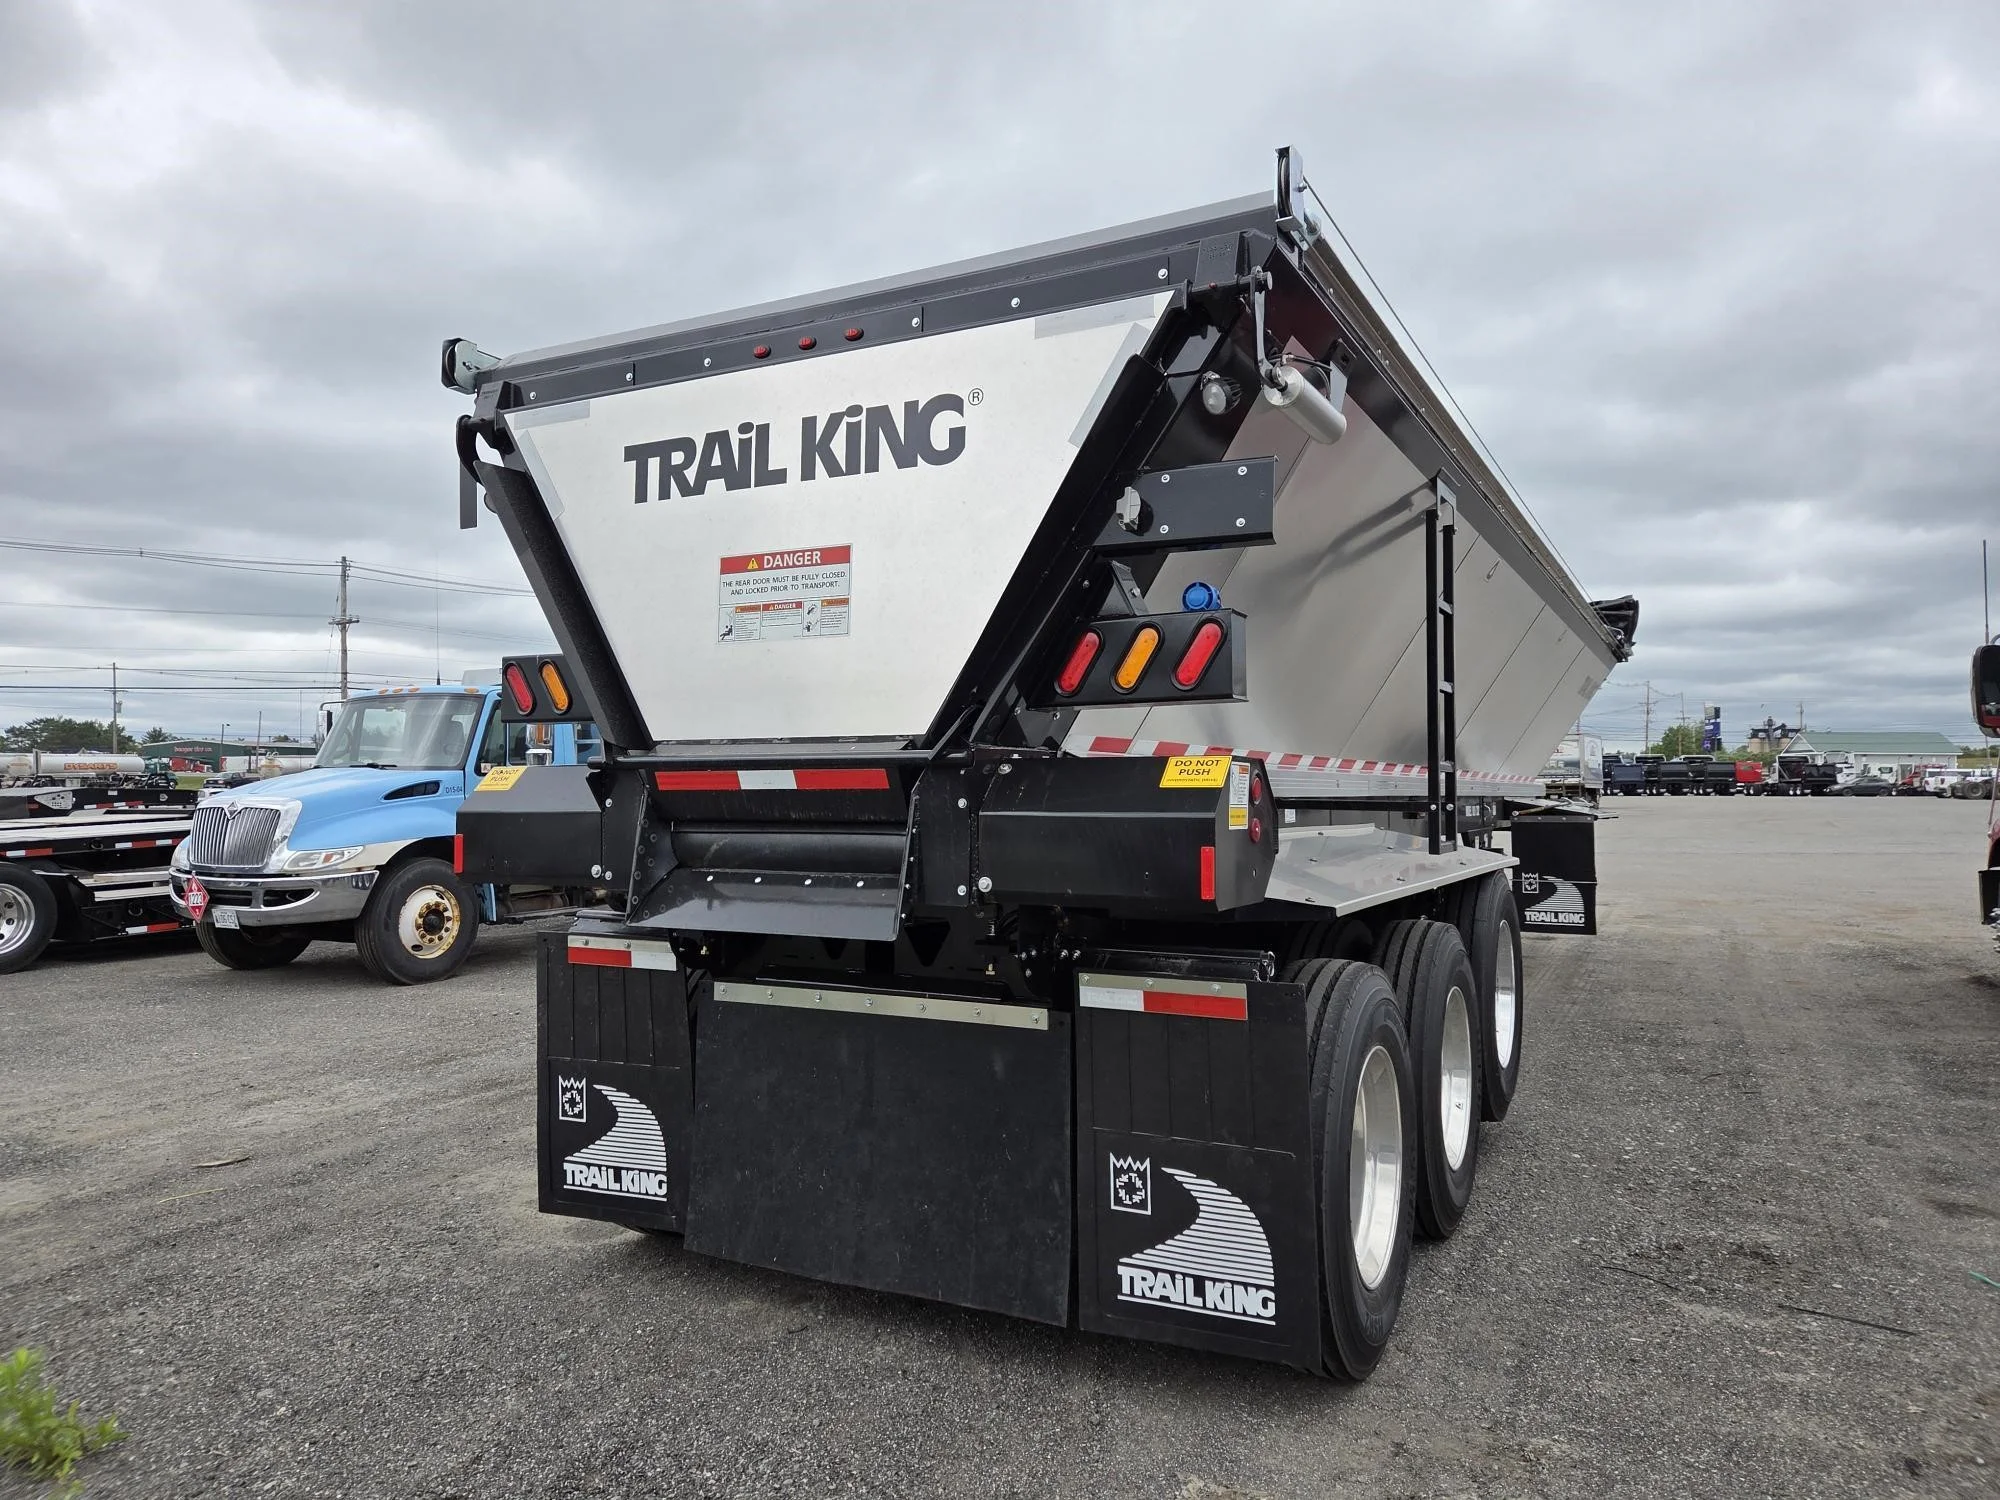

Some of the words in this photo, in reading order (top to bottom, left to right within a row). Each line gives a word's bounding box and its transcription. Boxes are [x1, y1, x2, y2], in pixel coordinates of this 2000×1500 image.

[763, 551, 821, 568] DANGER
[773, 576, 789, 584] MUST
[802, 573, 819, 581] FULLY
[746, 586, 769, 595] LOCKED
[771, 584, 788, 592] PRIOR
